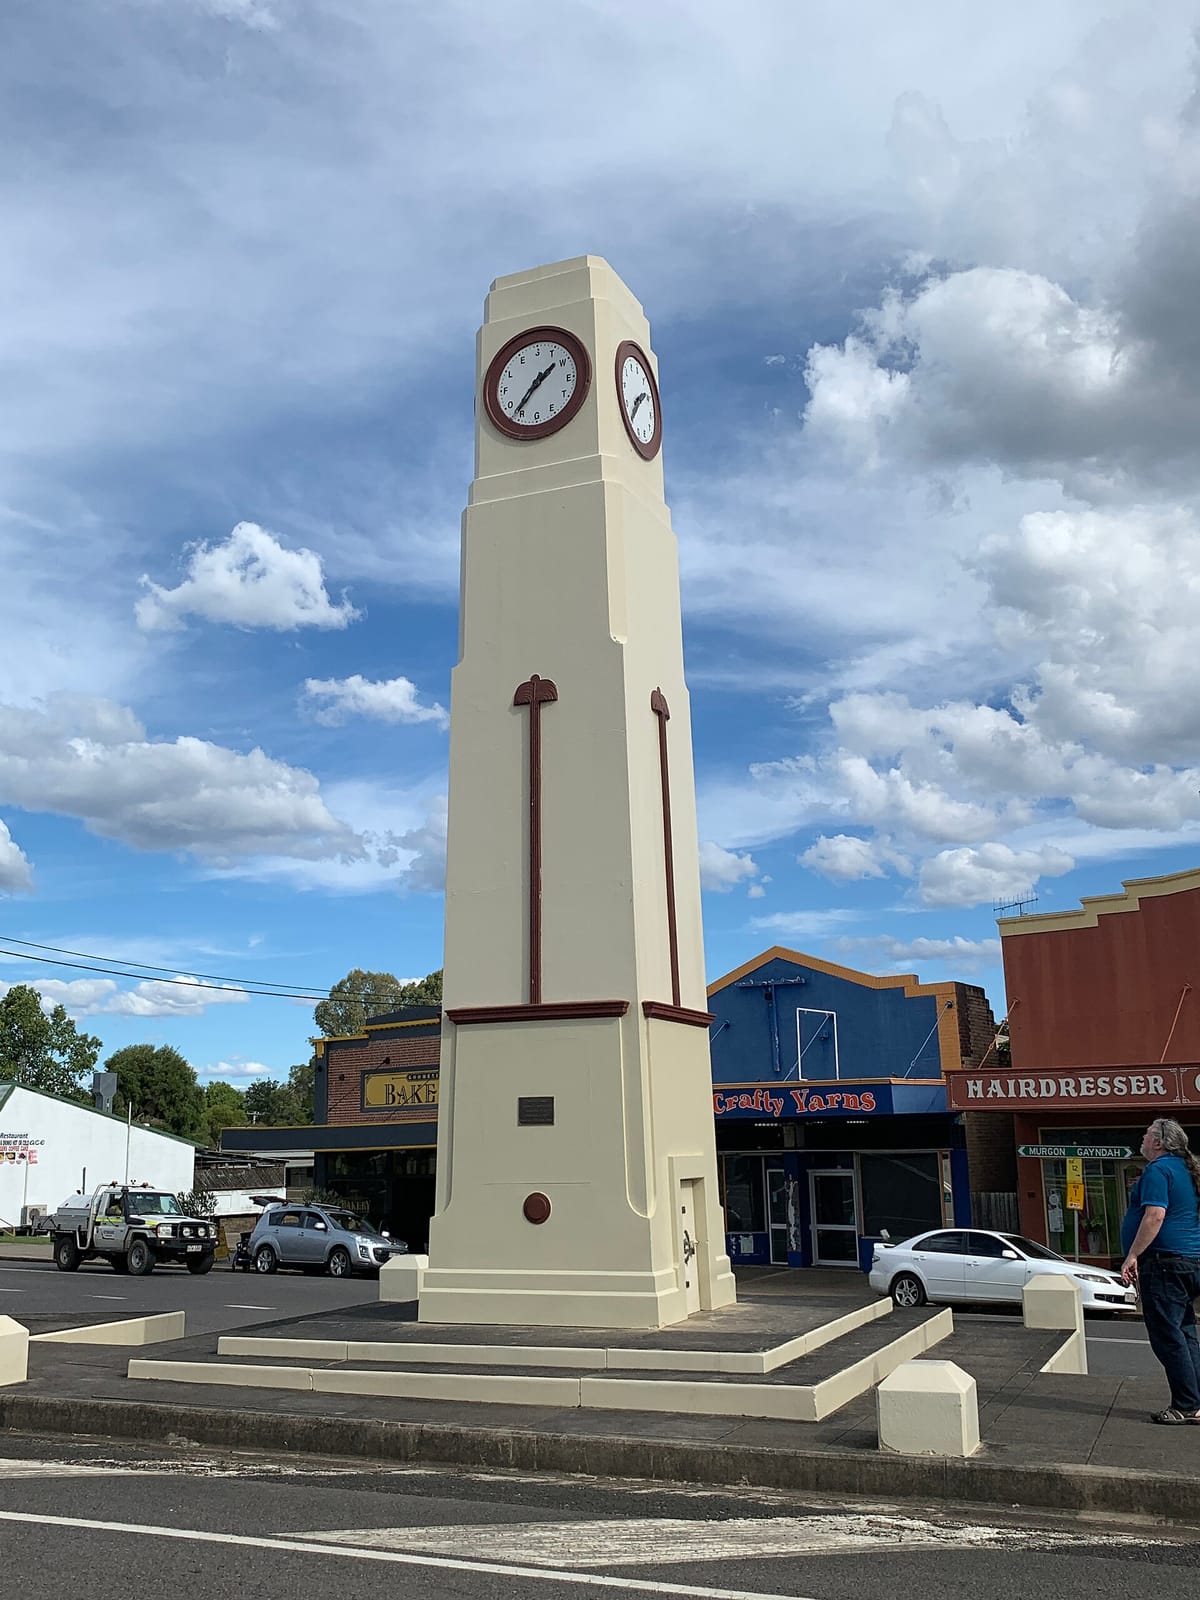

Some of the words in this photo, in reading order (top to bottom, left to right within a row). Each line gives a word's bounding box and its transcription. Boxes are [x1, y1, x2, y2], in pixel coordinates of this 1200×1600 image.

[966, 1075, 1167, 1098] HAIRDRESSER
[713, 1088, 784, 1117] Crafty
[790, 1088, 876, 1113] Yarns
[1029, 1147, 1066, 1156] MURGON
[1076, 1147, 1121, 1157] GAYNDAH
